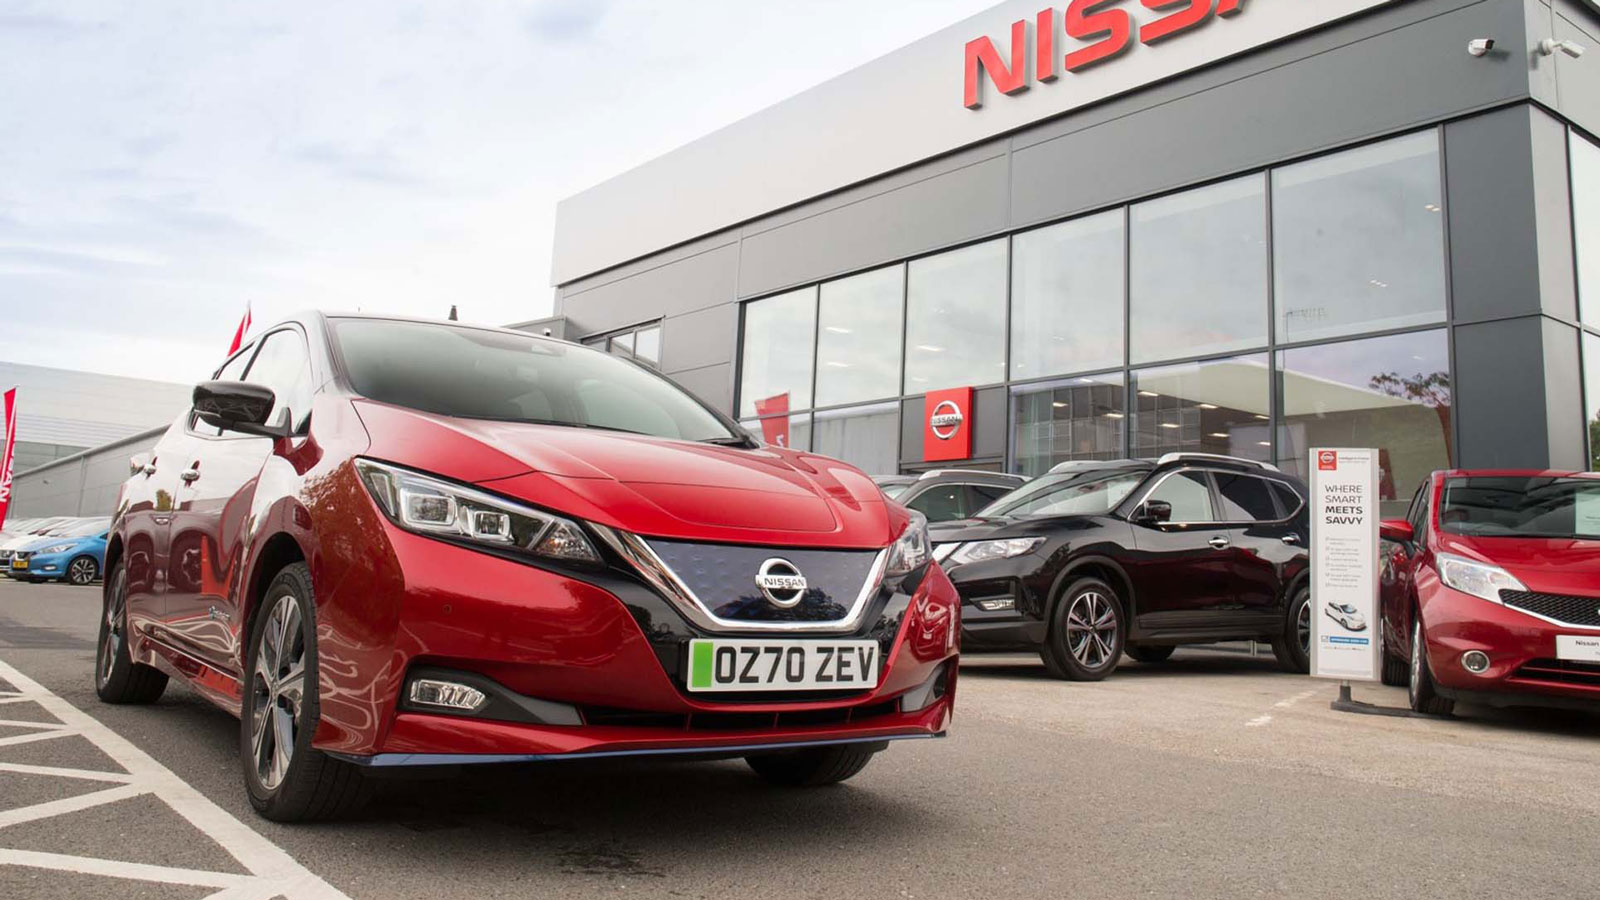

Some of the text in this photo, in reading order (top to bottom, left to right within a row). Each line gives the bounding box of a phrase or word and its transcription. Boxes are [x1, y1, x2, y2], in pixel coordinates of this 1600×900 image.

[964, 0, 1242, 110] NISS
[1325, 485, 1363, 493] WHERE
[1325, 495, 1363, 503] SMART
[1325, 506, 1363, 514] MEETS
[1325, 516, 1363, 524] SAVVY
[764, 577, 804, 586] NISSAN
[715, 646, 875, 684] OZ70 ZEV
